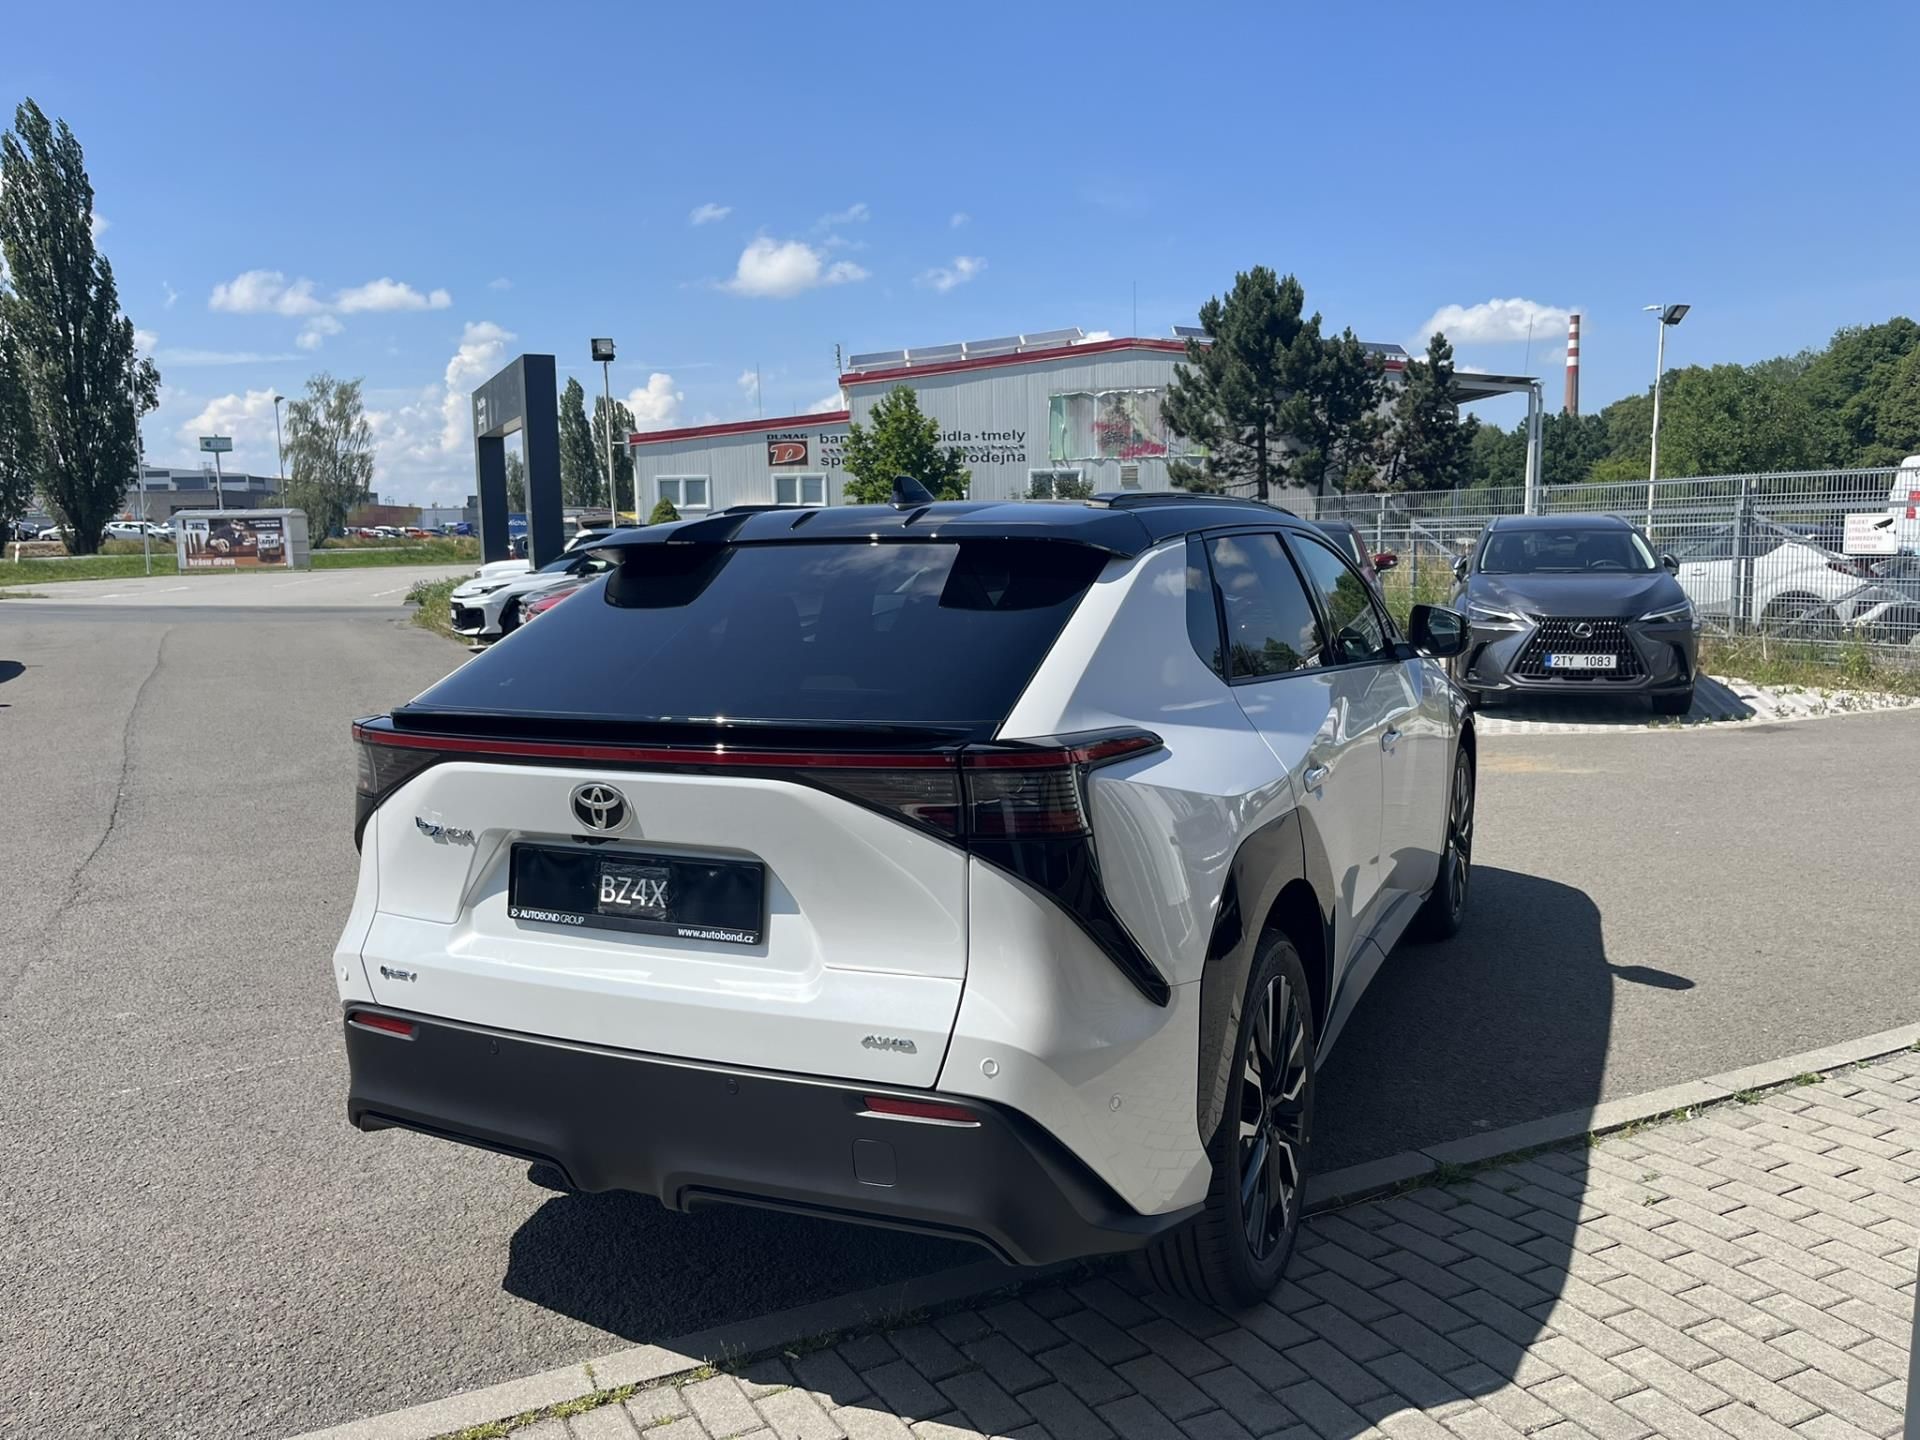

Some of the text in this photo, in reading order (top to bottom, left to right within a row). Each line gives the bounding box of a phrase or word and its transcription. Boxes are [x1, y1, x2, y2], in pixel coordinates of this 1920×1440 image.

[981, 429, 1026, 443] tmely
[1554, 655, 1611, 667] 2TY 1083
[600, 874, 669, 908] BZ4X
[519, 909, 584, 925] AUTOBOND GROUP
[677, 928, 754, 943] www.autobond.cz
